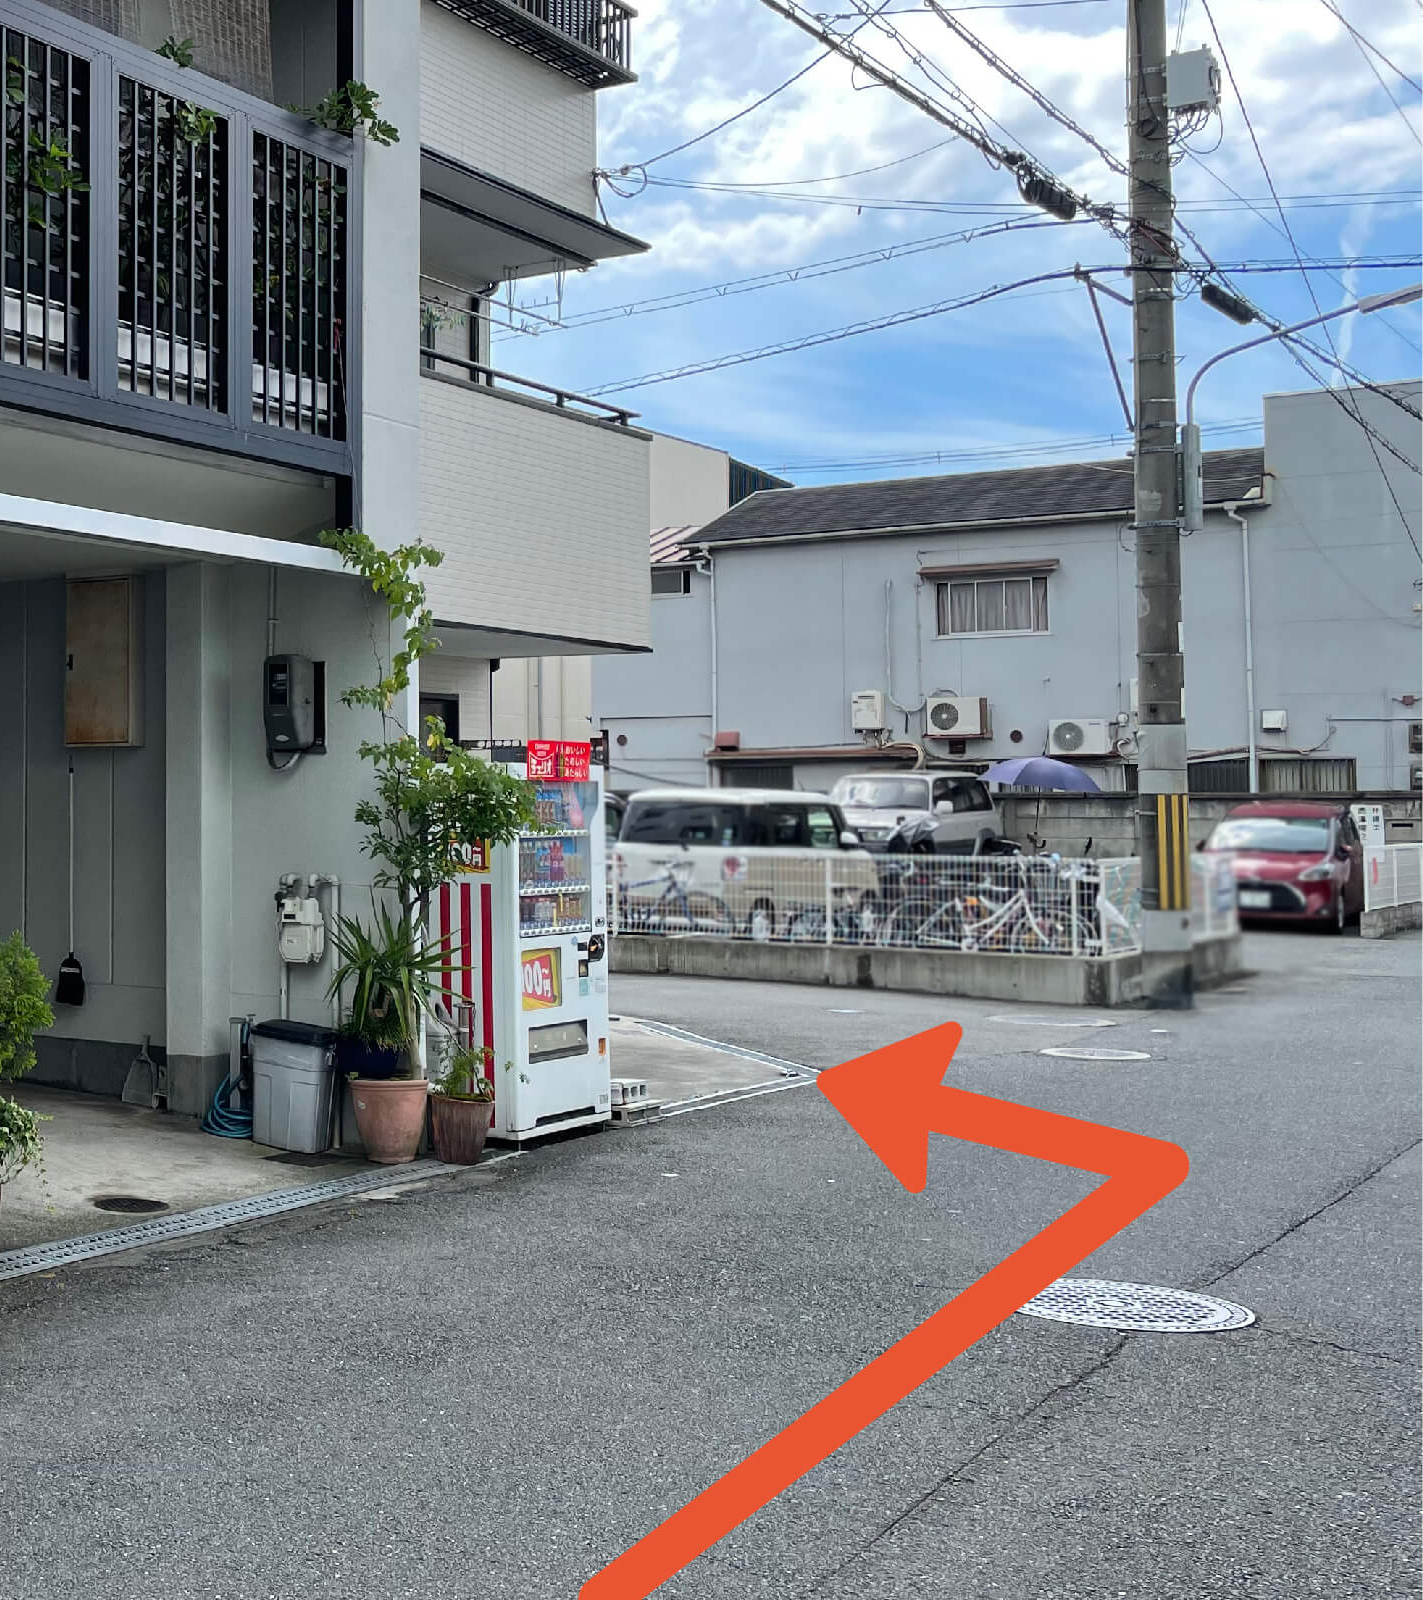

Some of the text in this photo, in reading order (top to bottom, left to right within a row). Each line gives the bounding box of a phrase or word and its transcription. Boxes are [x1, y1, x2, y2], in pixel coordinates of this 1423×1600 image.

[565, 745, 586, 755] おいしい
[531, 757, 552, 775] チェリオ
[565, 757, 586, 767] たのしい
[565, 768, 588, 778] あたらしい
